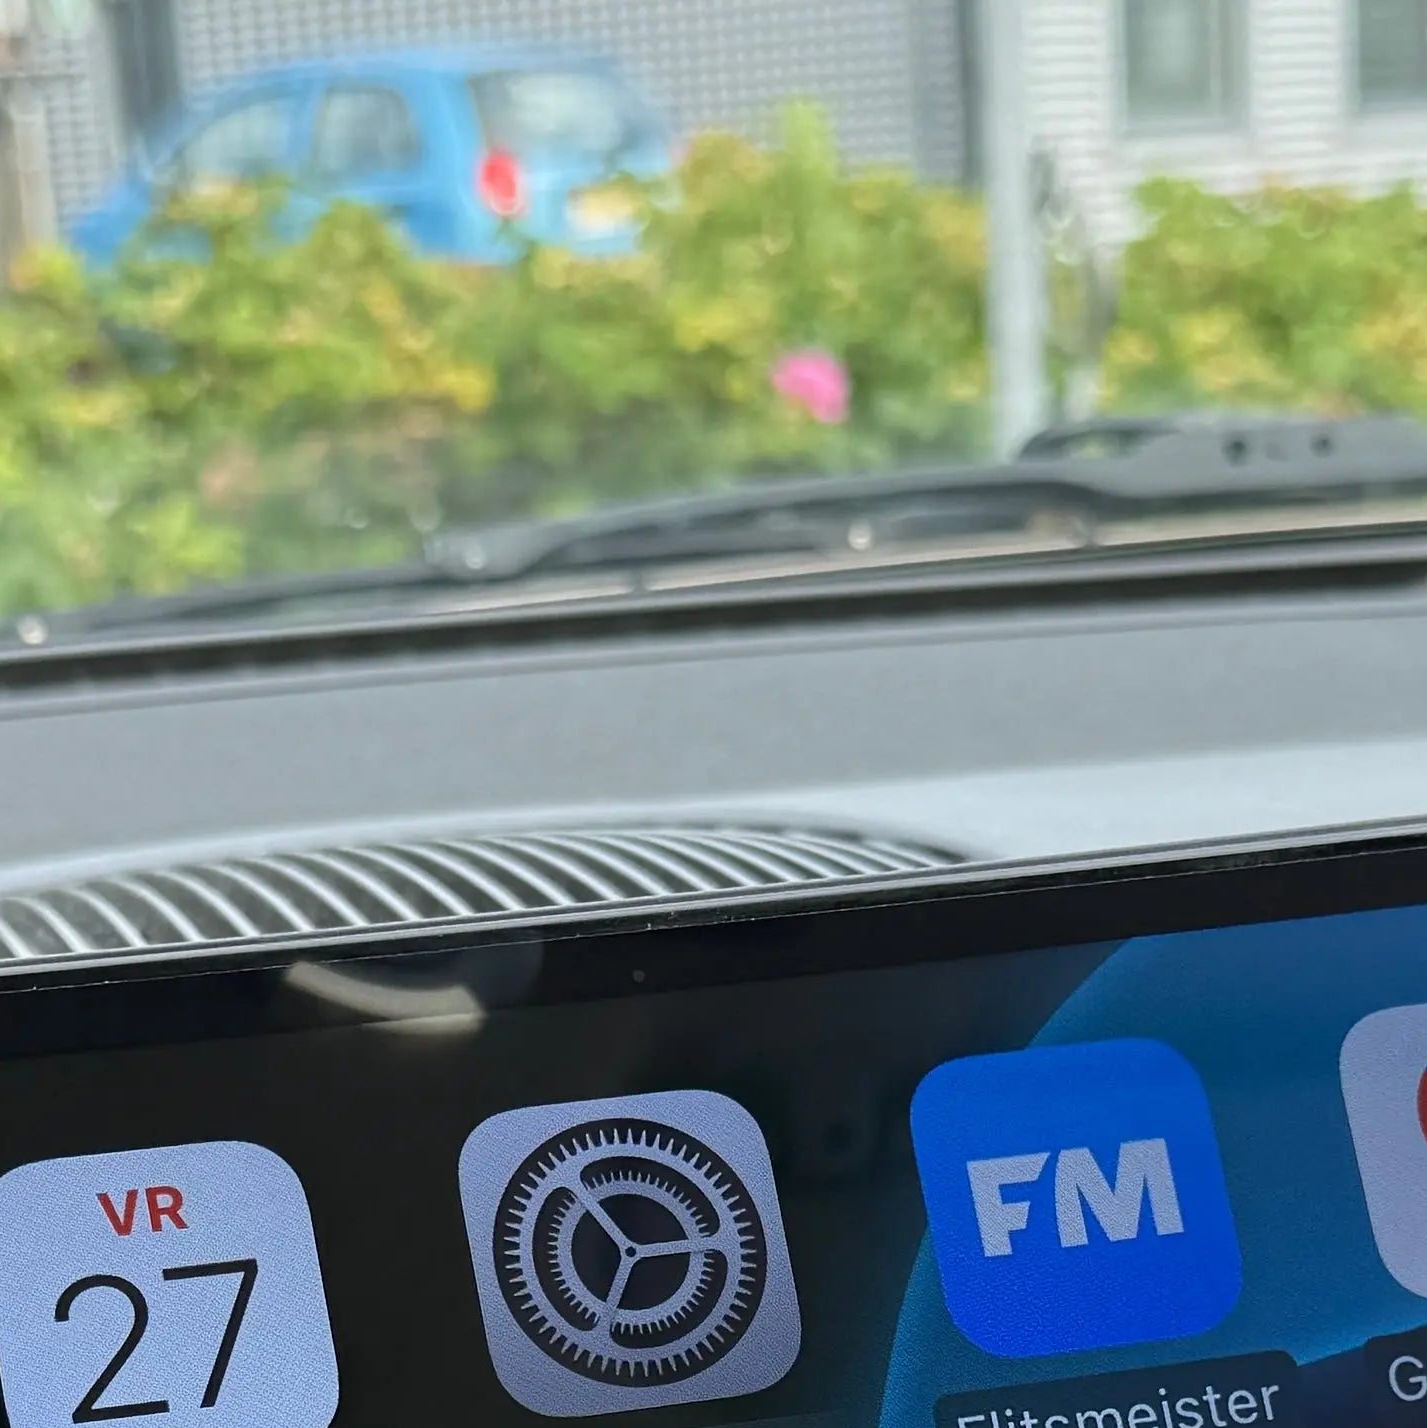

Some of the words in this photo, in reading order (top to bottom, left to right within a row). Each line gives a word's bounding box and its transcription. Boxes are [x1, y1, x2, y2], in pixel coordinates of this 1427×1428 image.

[95, 1186, 190, 1237] VR
[966, 1136, 1185, 1259] FM
[53, 1257, 260, 1425] 27
